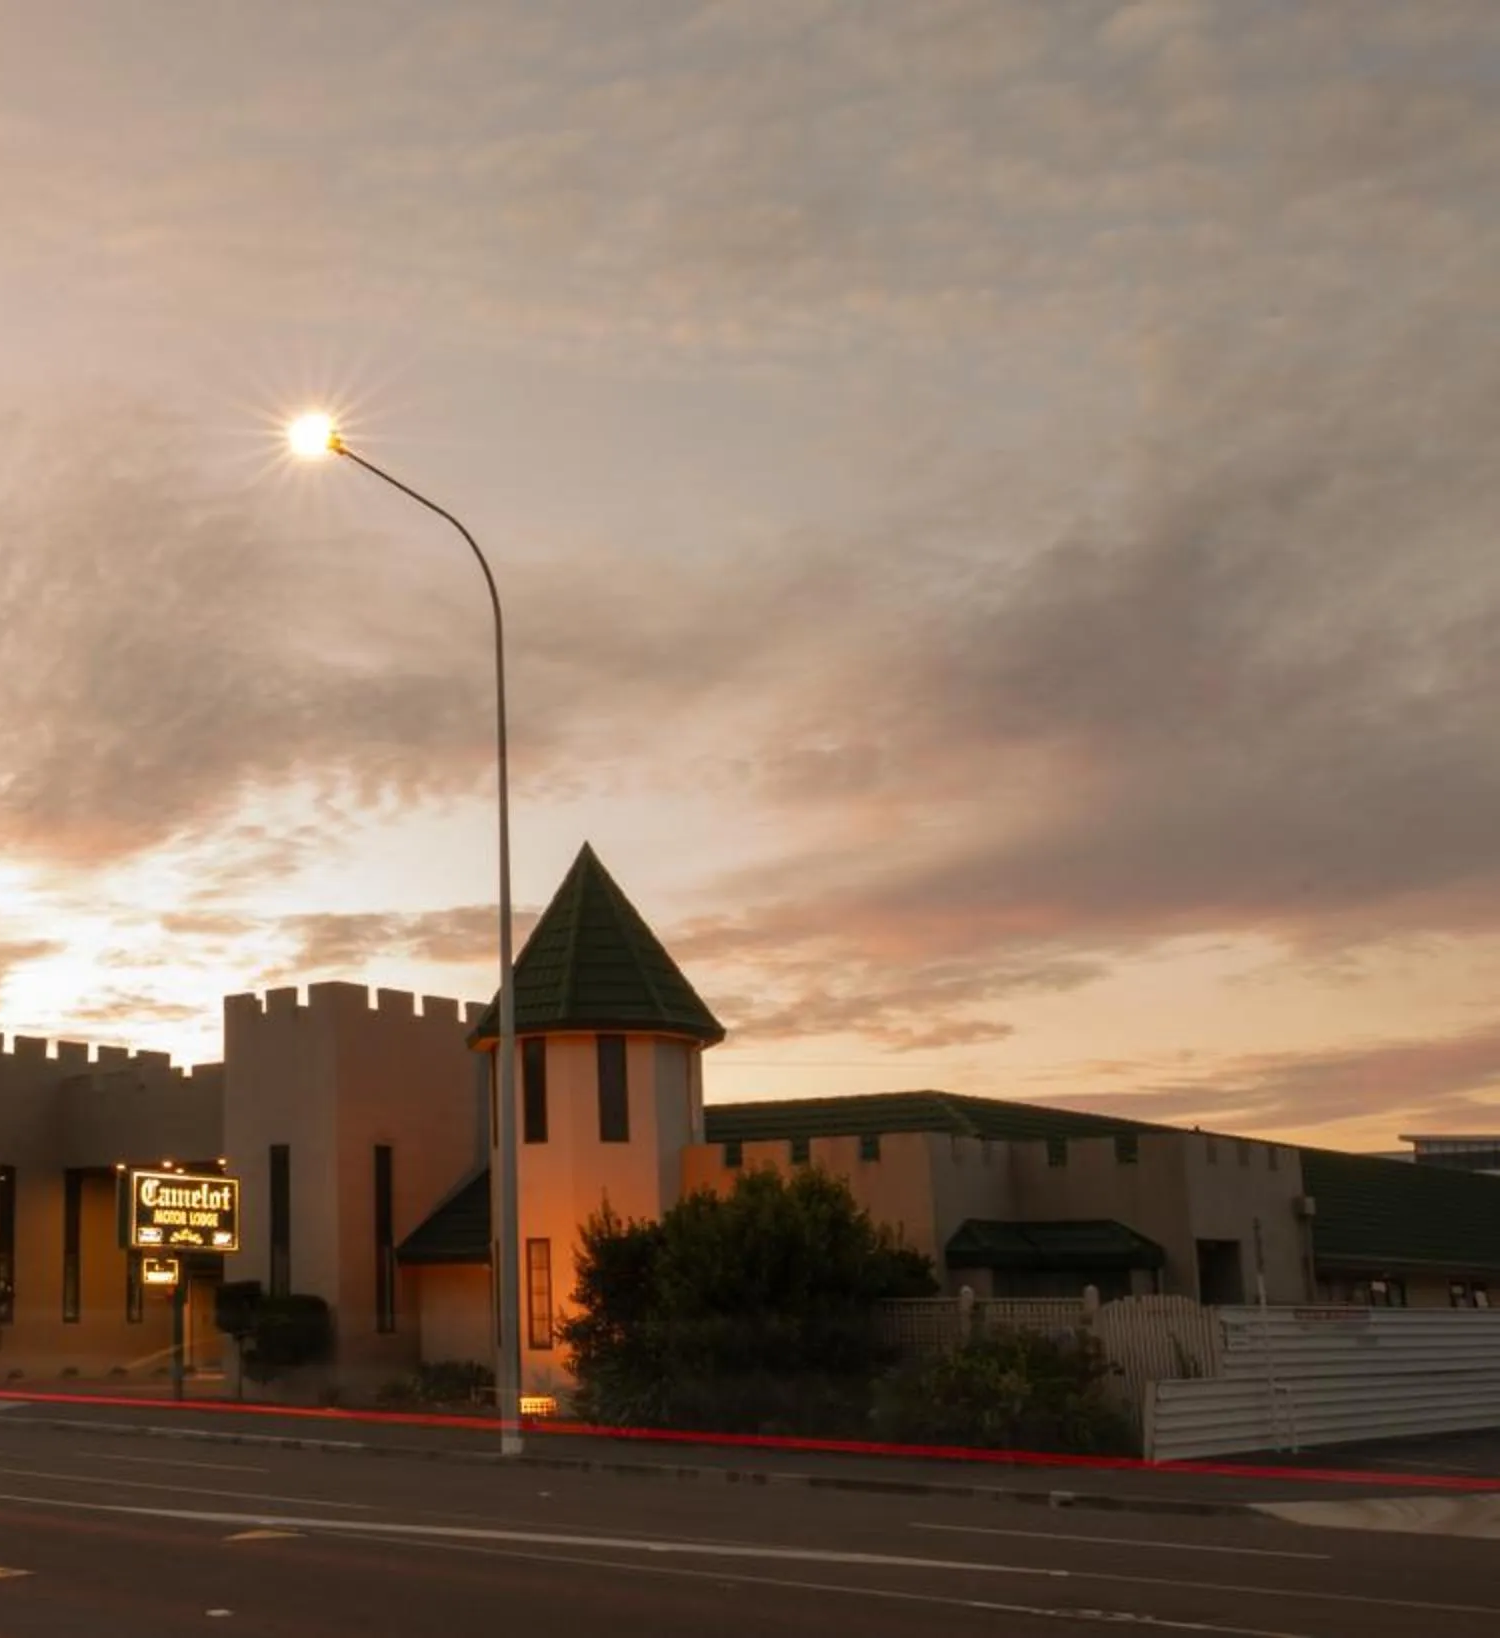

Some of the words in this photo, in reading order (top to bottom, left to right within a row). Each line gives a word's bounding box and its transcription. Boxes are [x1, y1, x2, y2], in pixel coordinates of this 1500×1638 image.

[141, 1179, 231, 1211] Camelot
[153, 1209, 187, 1225] MOTOR
[189, 1211, 219, 1227] LODGE
